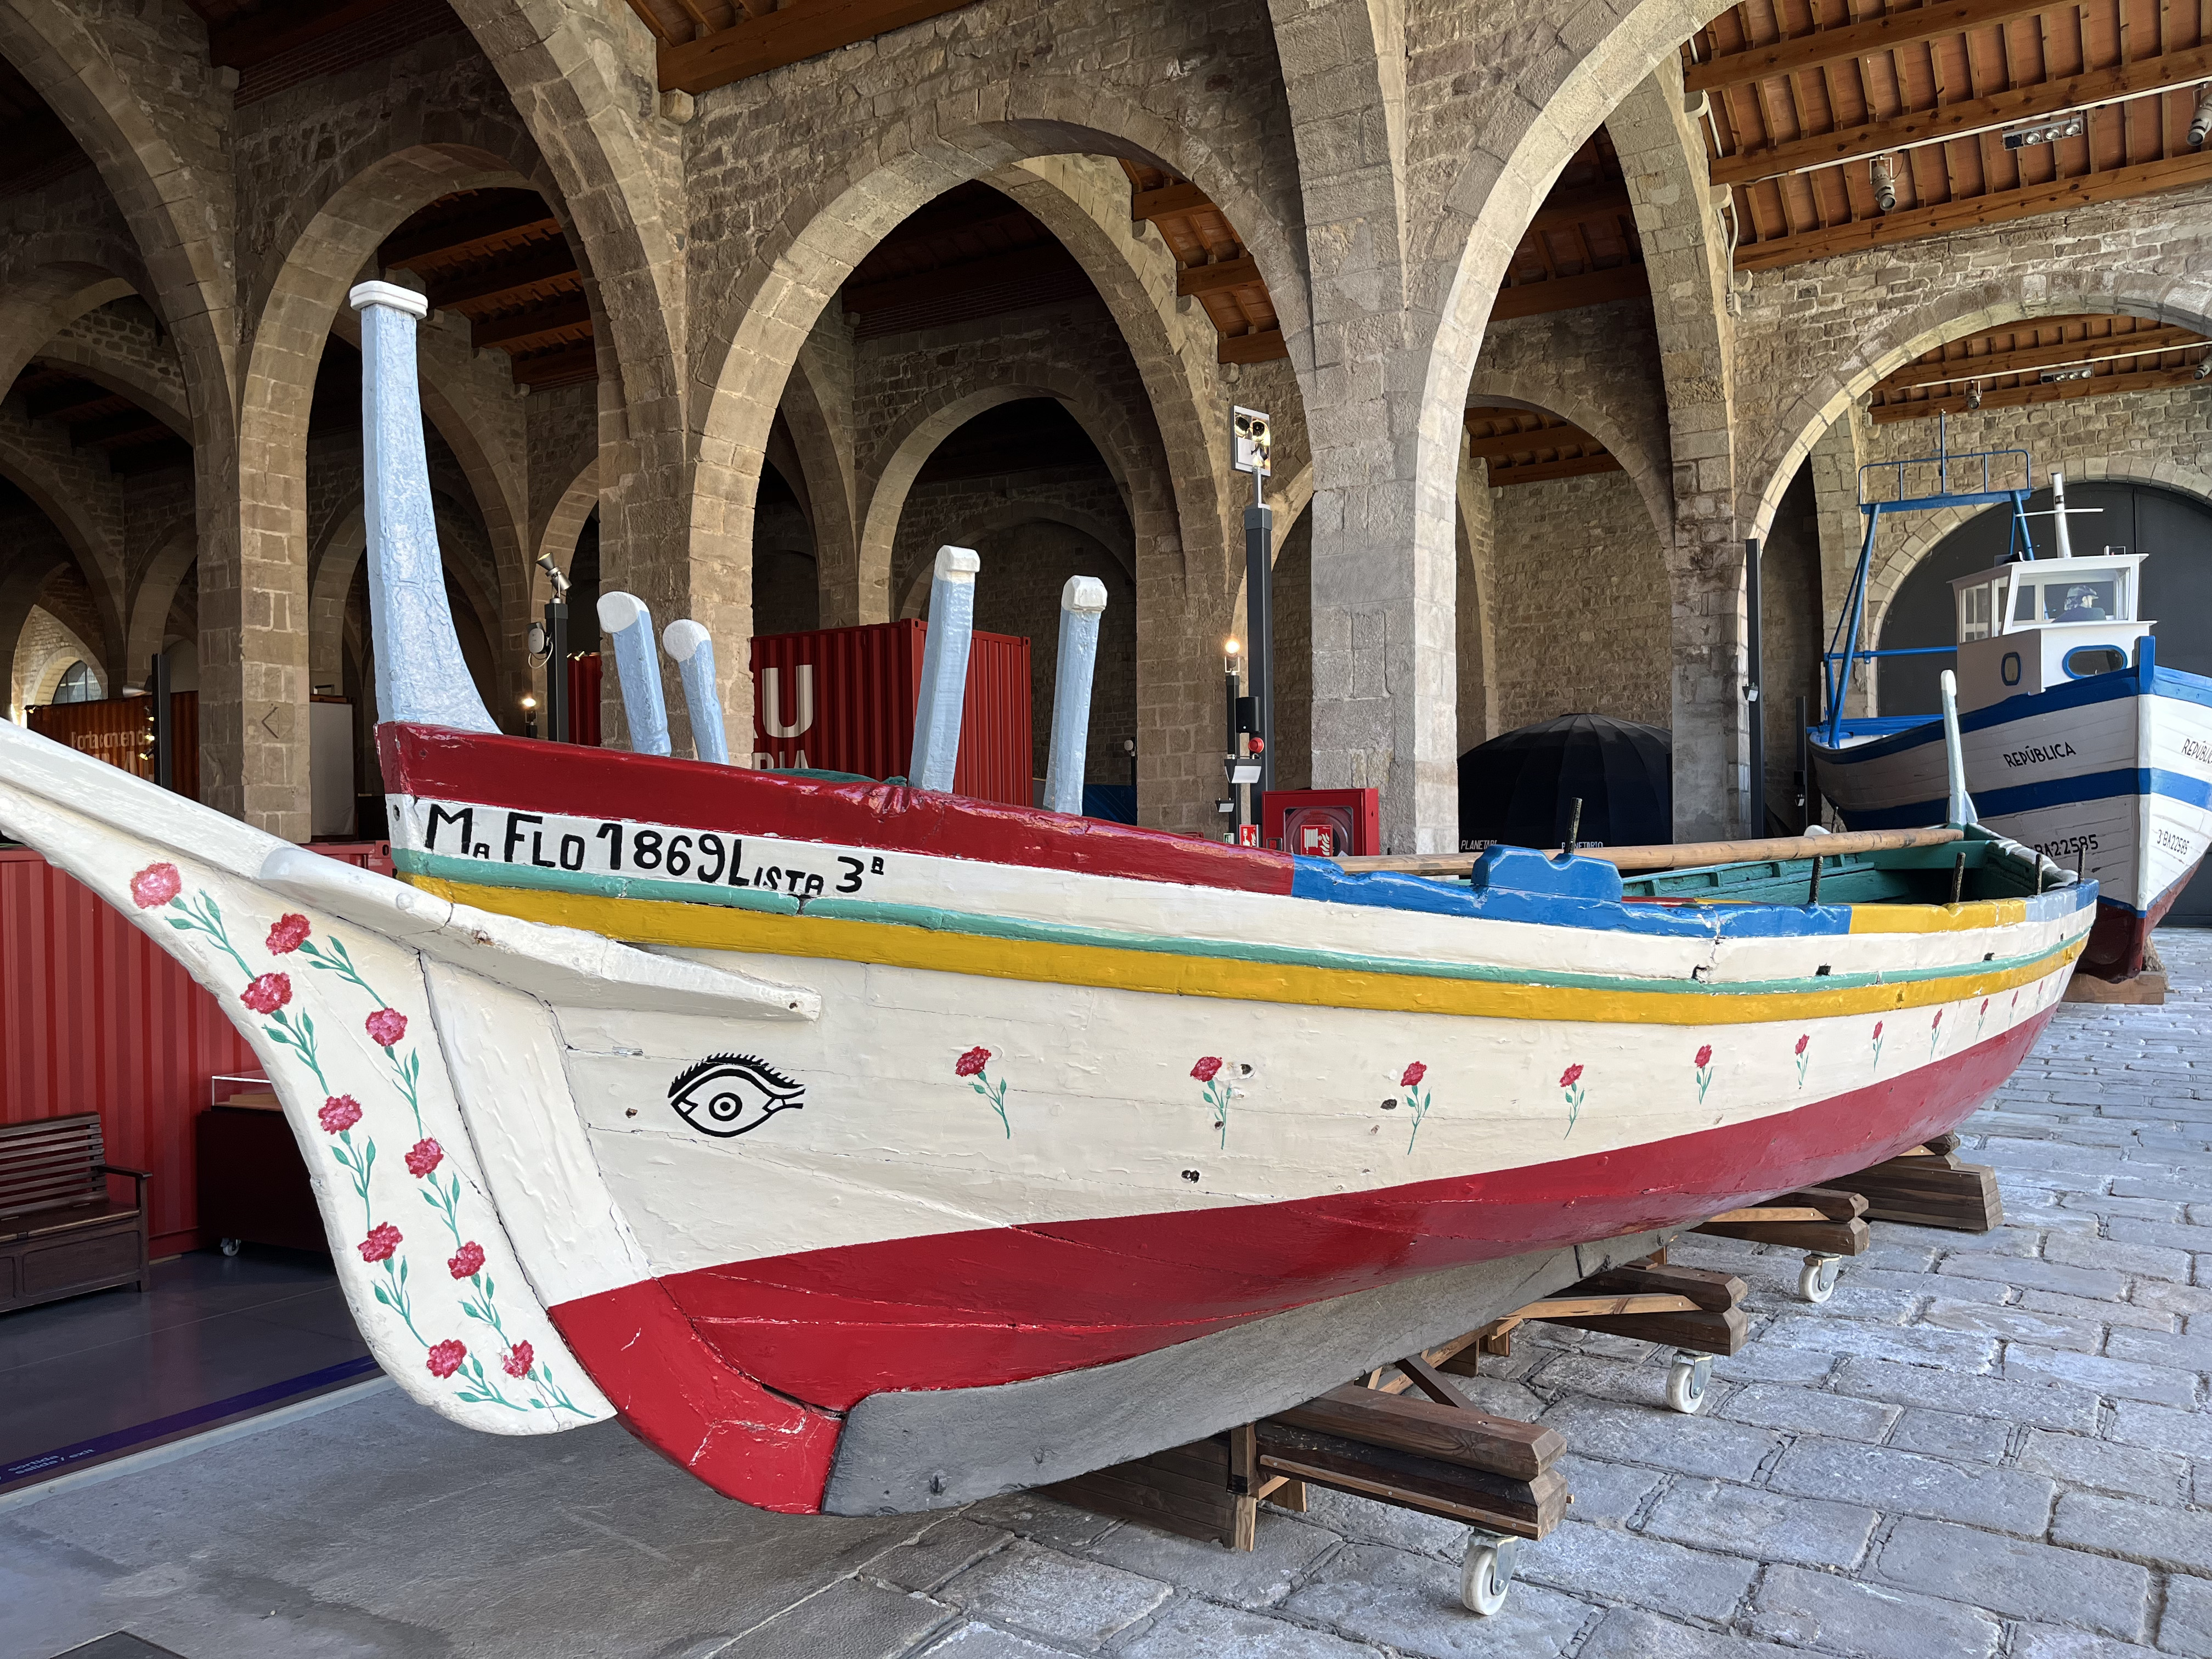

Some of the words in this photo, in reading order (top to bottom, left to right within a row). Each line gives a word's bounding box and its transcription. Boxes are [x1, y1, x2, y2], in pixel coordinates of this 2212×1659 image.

[753, 664, 814, 738] U
[2003, 742, 2076, 768] REPÚBLICA
[2181, 738, 2212, 765] REPÚBLIC
[504, 811, 585, 871] FLO
[1561, 841, 1604, 849] PNETARIO
[69, 1449, 95, 1458] exit
